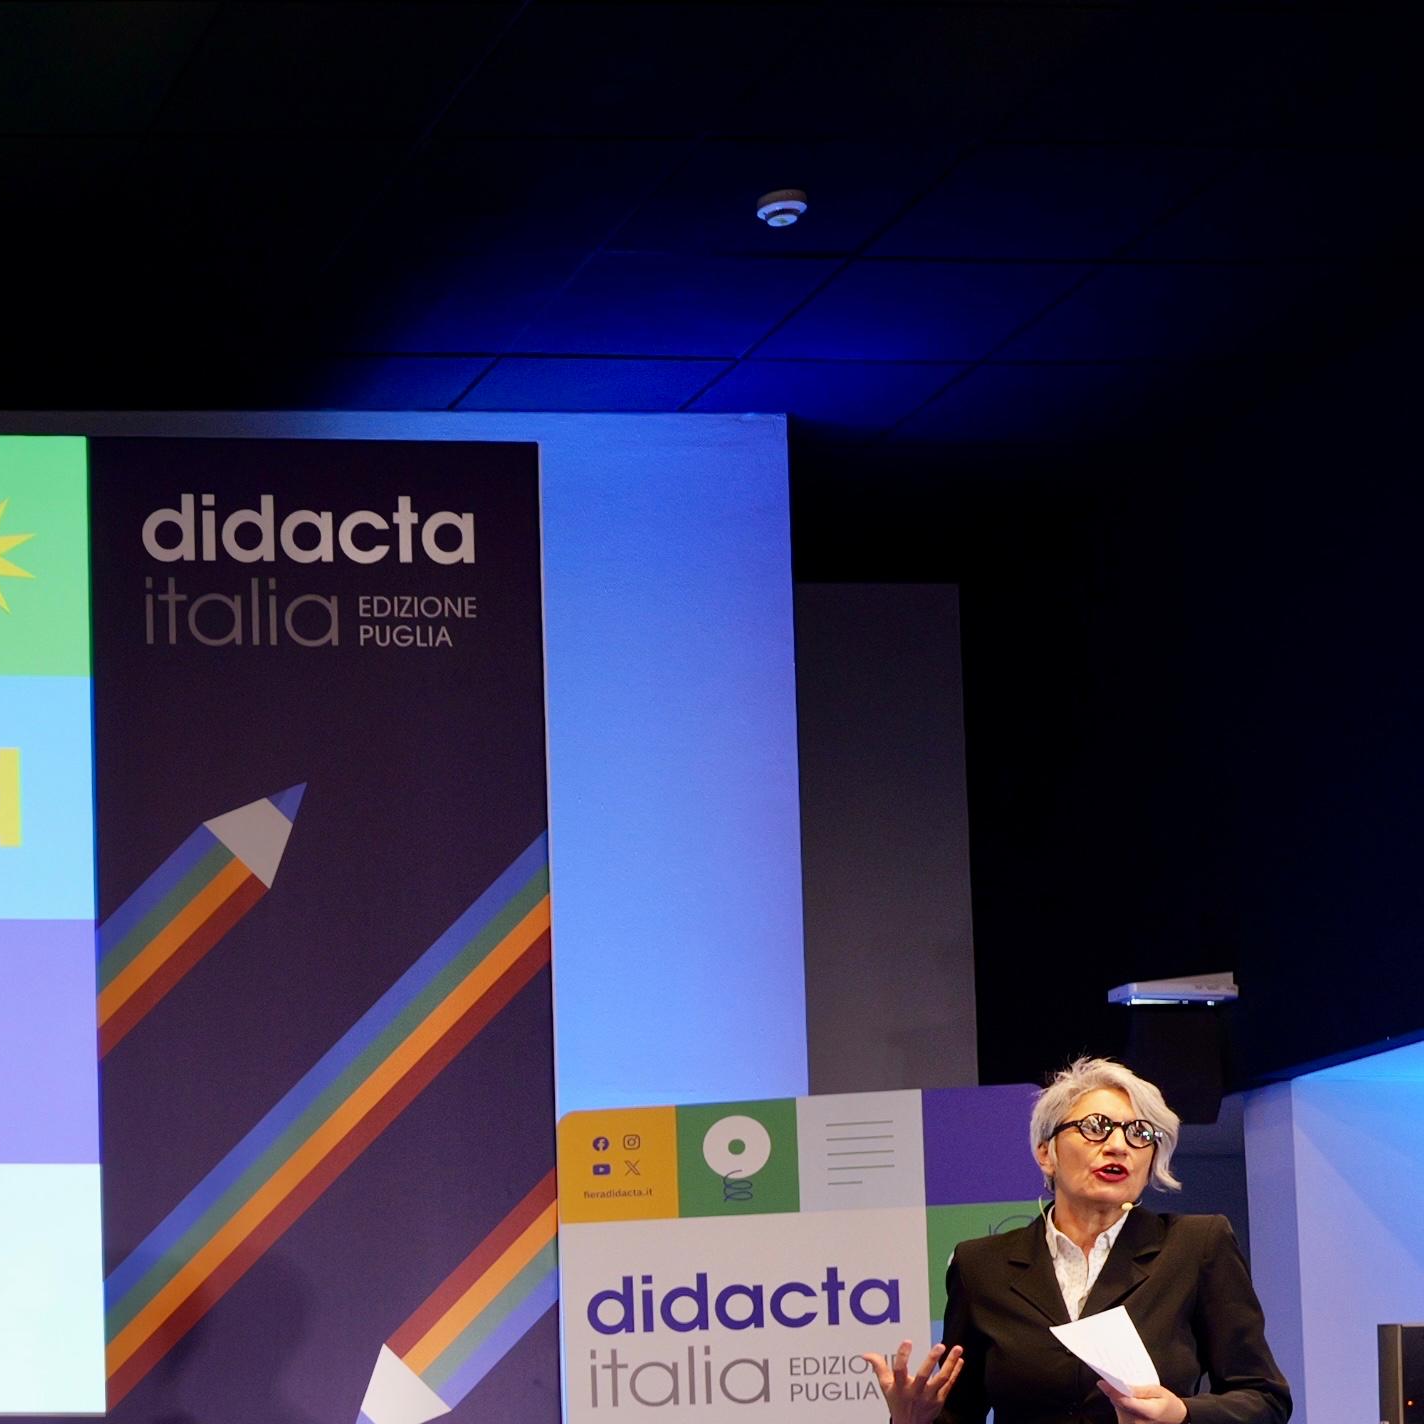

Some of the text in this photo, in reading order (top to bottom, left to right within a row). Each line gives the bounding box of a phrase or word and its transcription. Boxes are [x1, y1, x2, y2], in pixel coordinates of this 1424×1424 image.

[141, 493, 477, 565] didacta
[144, 577, 341, 647] italia
[357, 596, 478, 619] EDIZIONE
[358, 624, 453, 648] PUGLIA
[587, 1267, 901, 1336] didacta
[589, 1345, 771, 1409] italia
[790, 1381, 880, 1402] PUGLIA
